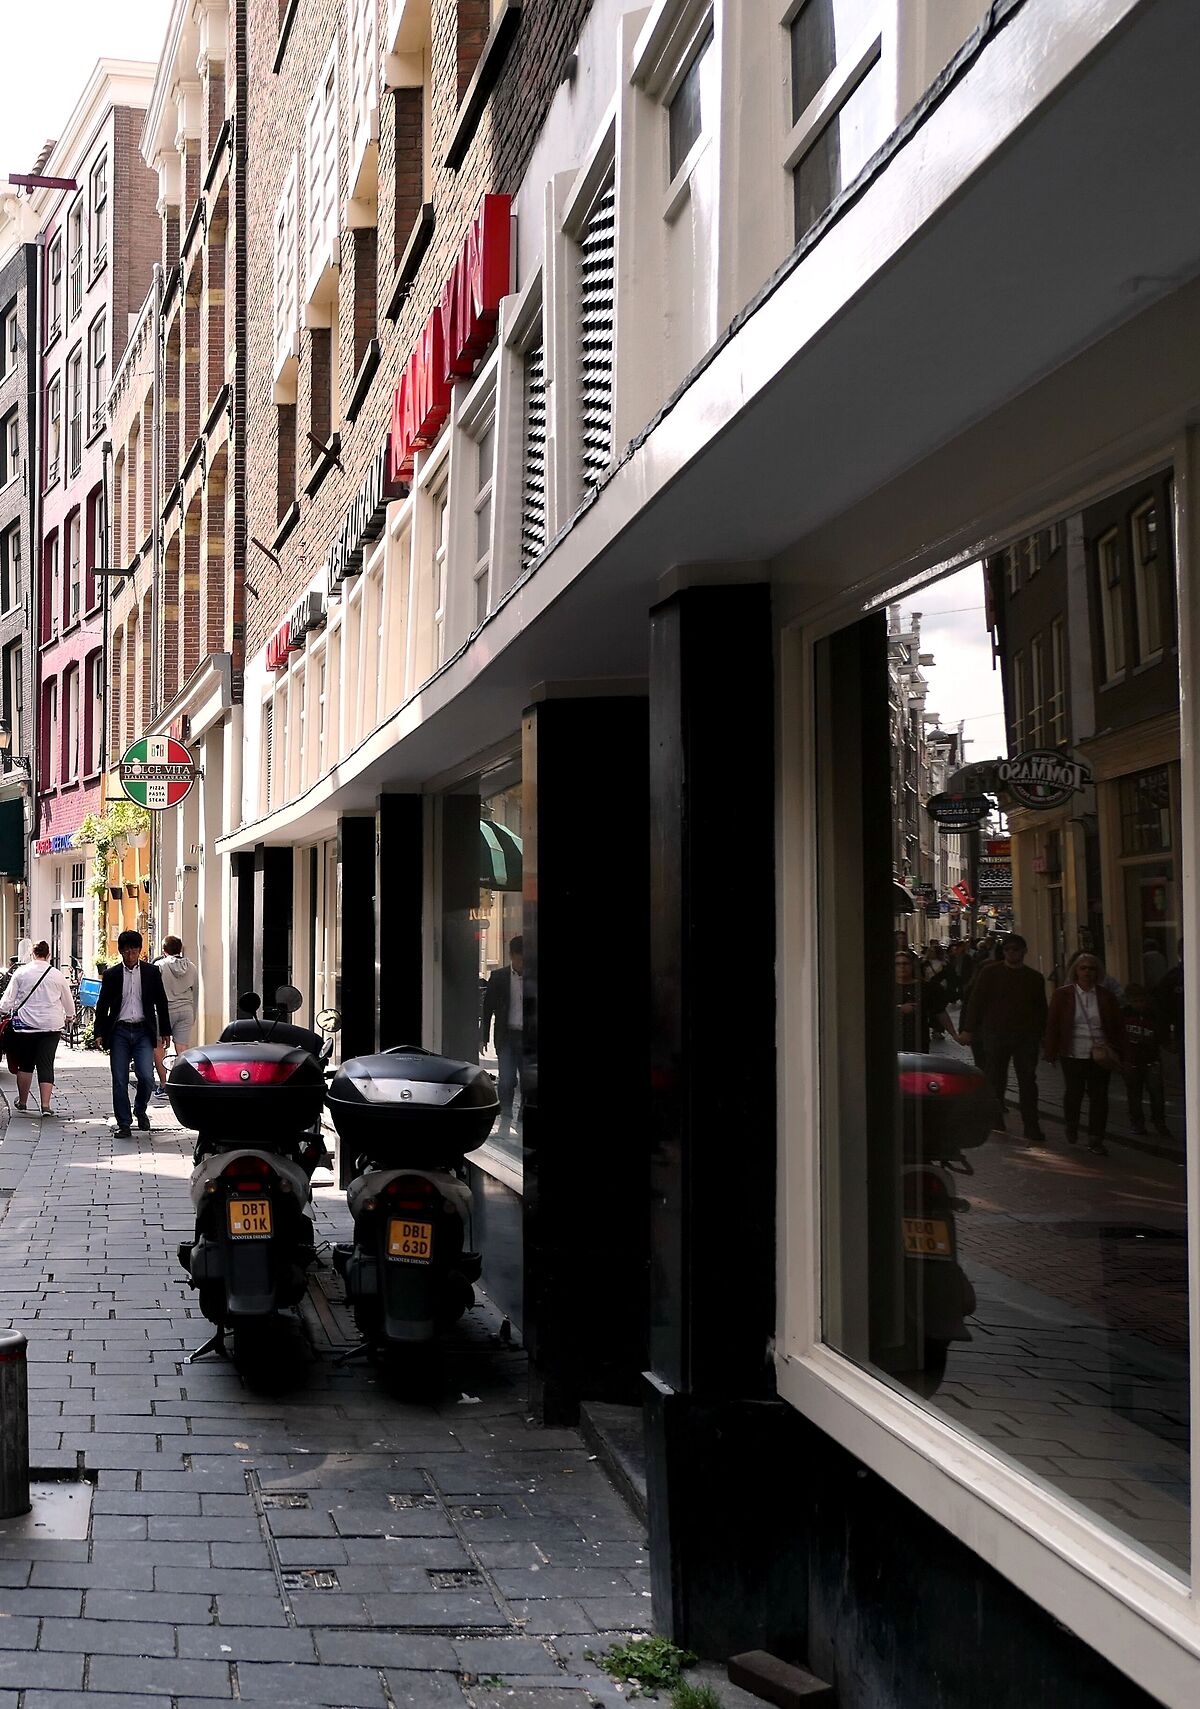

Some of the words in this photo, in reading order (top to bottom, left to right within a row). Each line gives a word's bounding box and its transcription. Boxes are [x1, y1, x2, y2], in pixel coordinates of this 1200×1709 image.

[124, 765, 161, 774] DOLCE
[165, 765, 190, 774] VITA
[242, 1203, 267, 1216] DBT
[243, 1217, 268, 1231] 01K
[403, 1224, 428, 1239] DBL
[402, 1240, 429, 1255] 63D
